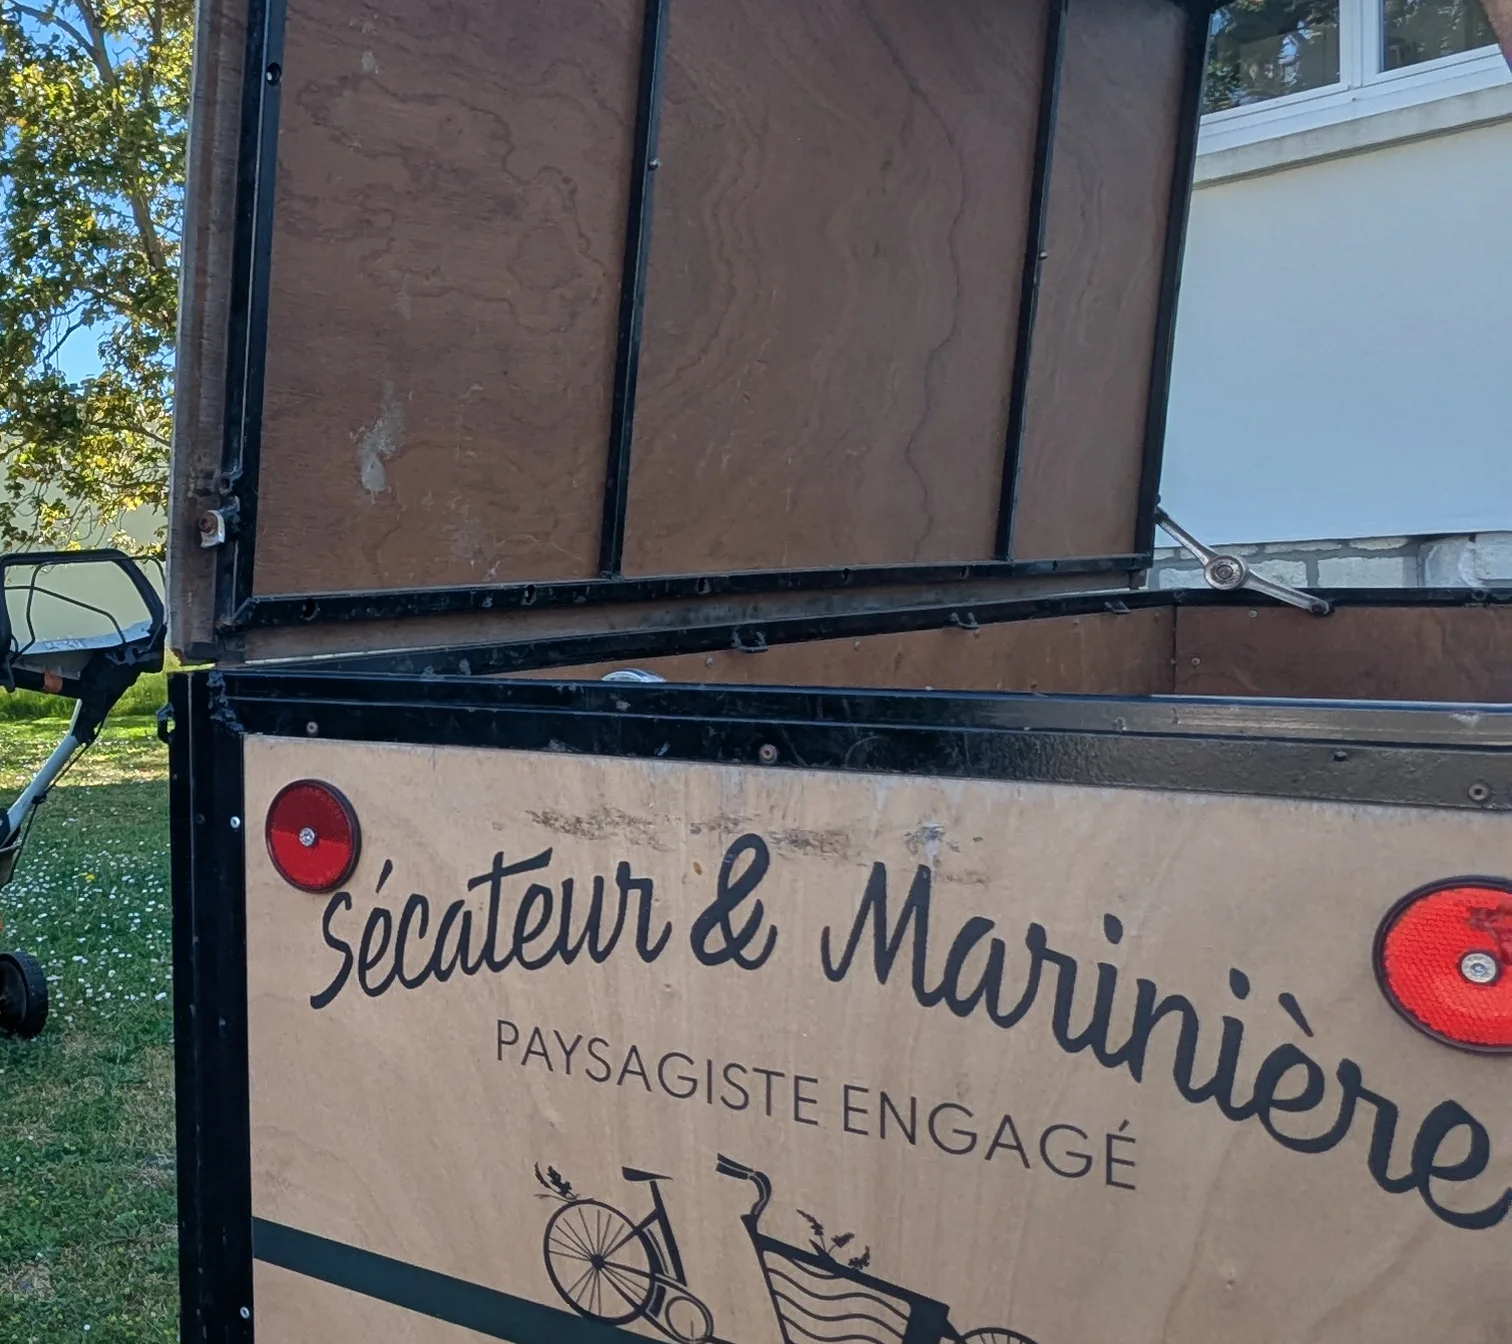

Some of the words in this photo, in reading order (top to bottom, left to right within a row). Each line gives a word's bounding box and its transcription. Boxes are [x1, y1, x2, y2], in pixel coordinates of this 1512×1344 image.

[497, 1019, 819, 1127] PAYSAGISTE
[843, 1084, 1138, 1191] ENGAGÉ
[690, 833, 778, 971] &
[821, 861, 1512, 1230] Marinière
